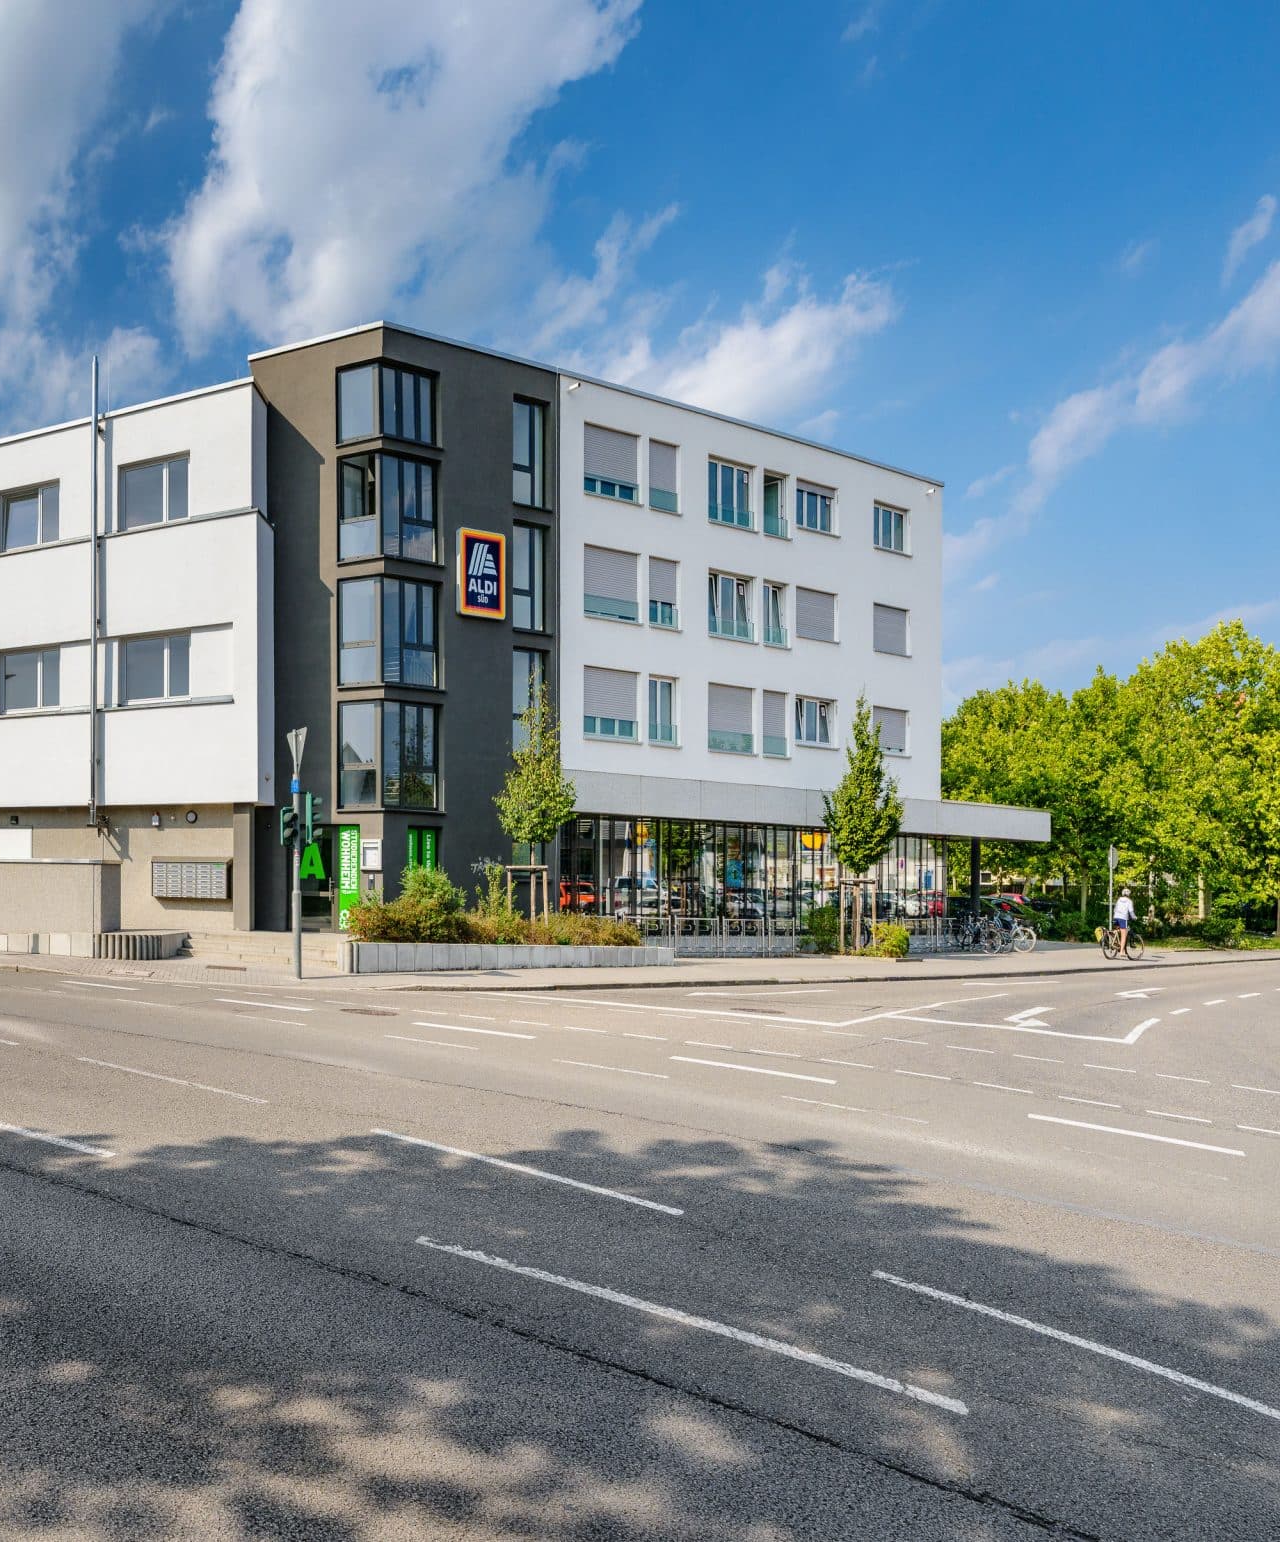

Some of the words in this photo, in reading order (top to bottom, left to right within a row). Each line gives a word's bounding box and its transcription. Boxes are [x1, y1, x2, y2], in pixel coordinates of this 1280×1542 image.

[468, 578, 497, 596] ALDI
[299, 842, 326, 879] A
[341, 830, 350, 890] WOHNHEIM
